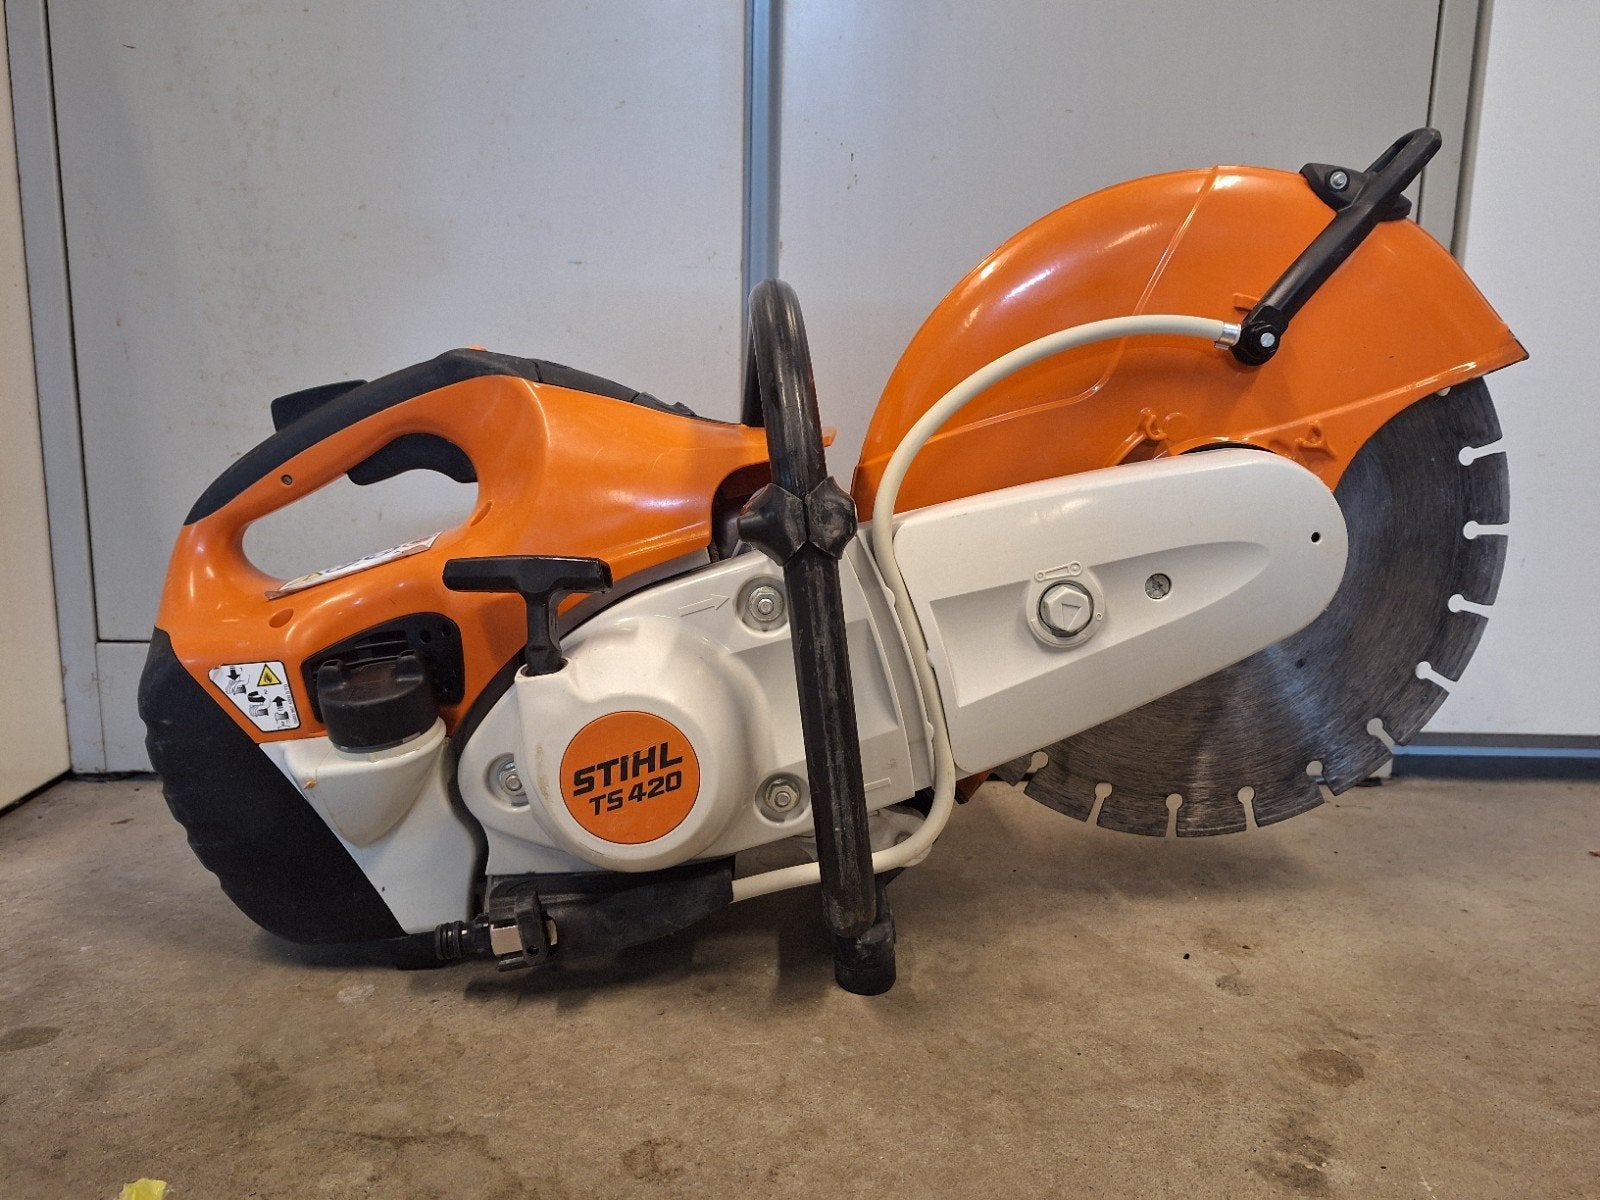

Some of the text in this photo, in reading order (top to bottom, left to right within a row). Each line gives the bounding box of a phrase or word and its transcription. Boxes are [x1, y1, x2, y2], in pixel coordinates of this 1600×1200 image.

[573, 742, 683, 796] STIHL
[589, 770, 682, 815] TS 420
